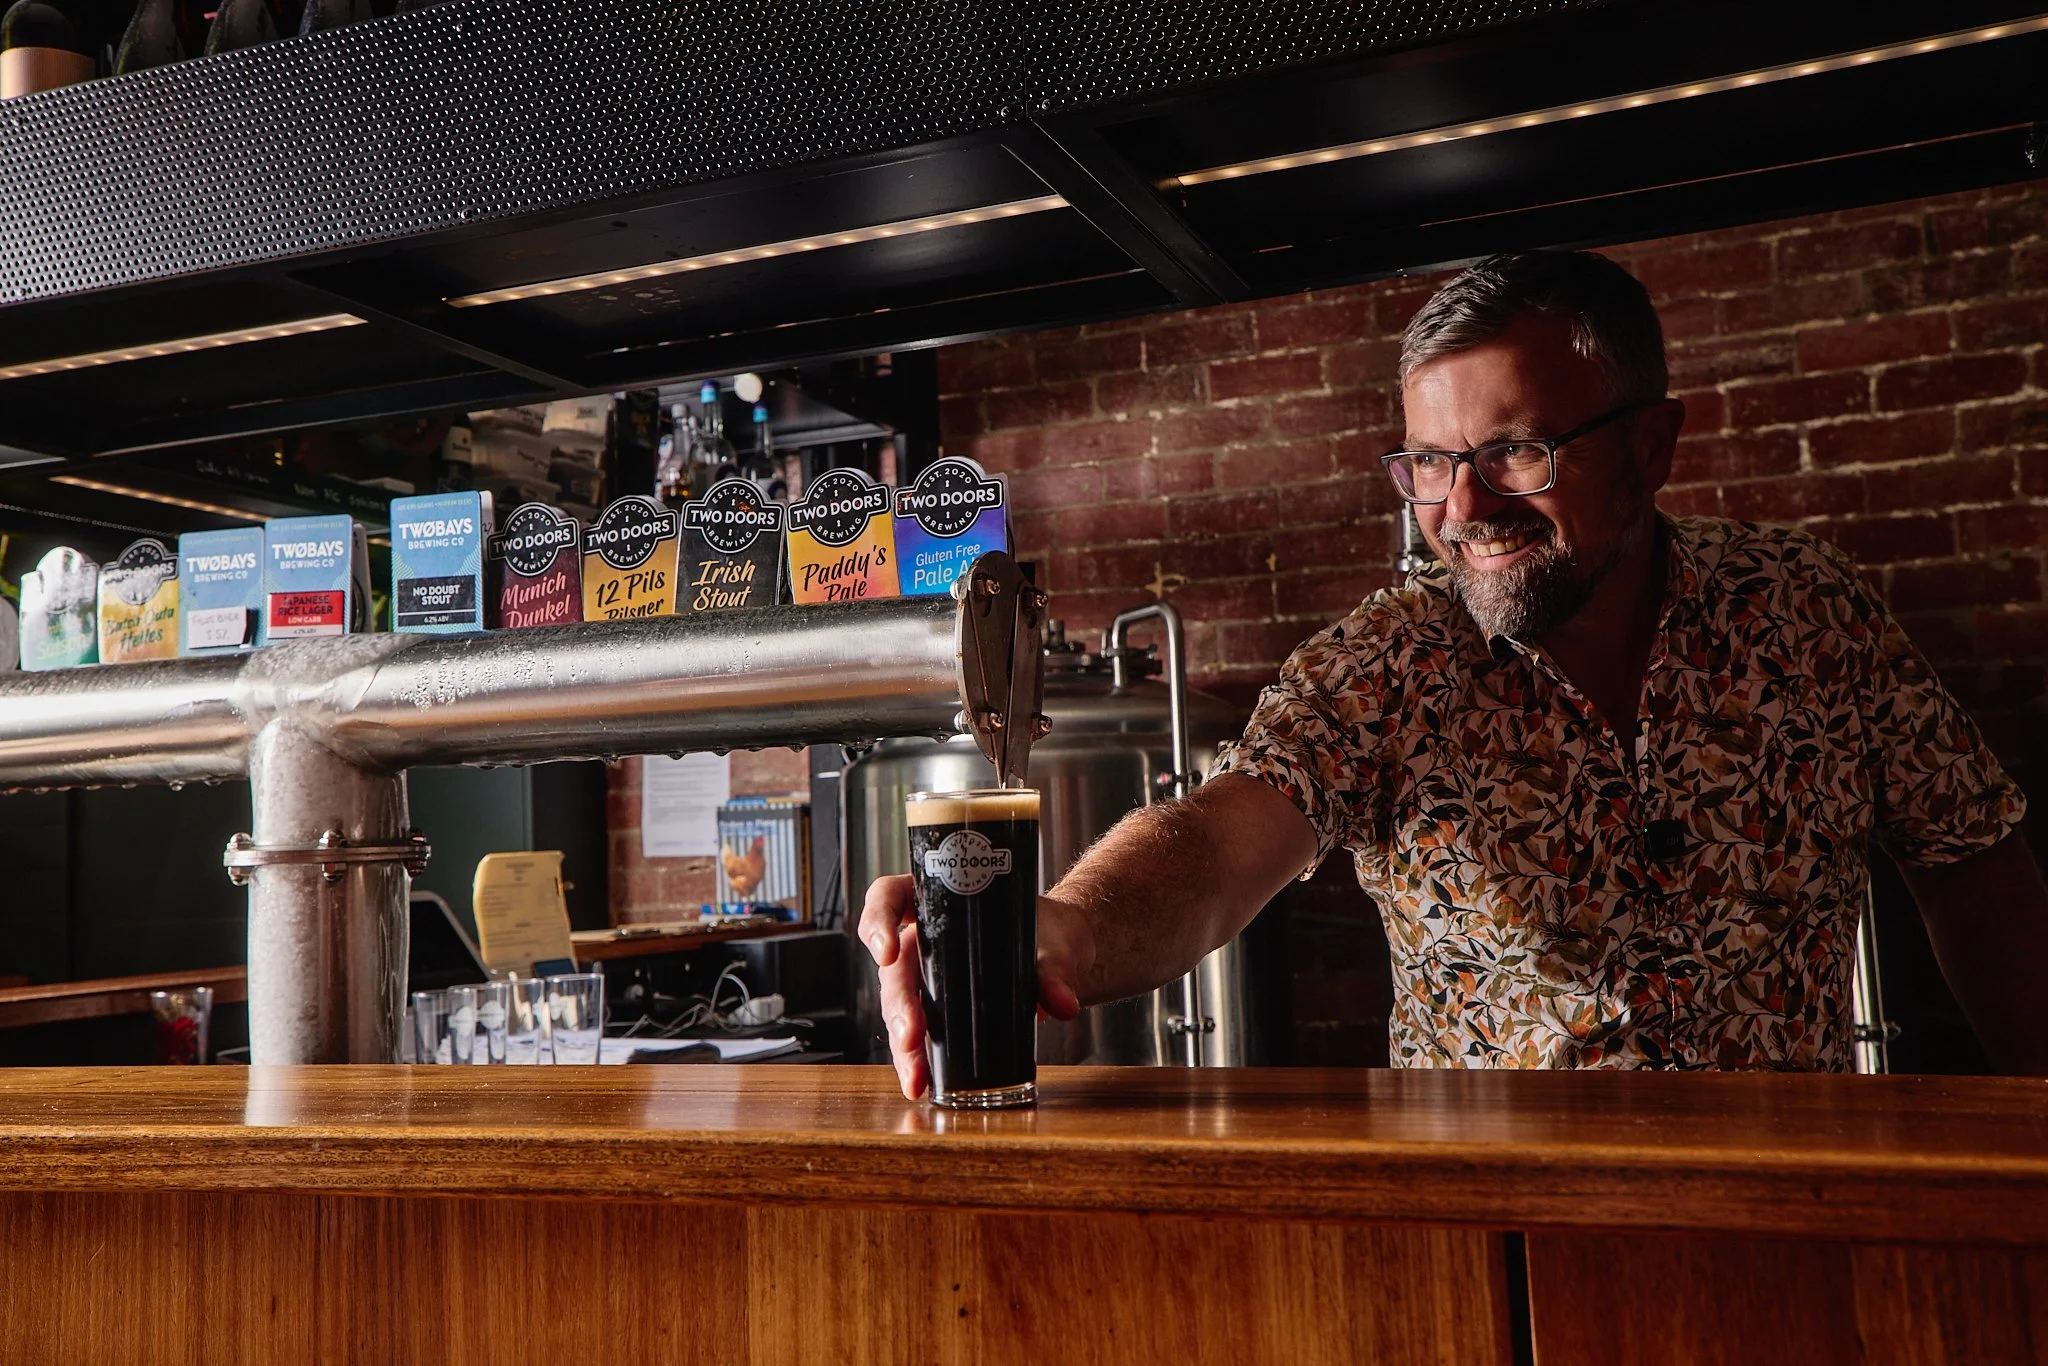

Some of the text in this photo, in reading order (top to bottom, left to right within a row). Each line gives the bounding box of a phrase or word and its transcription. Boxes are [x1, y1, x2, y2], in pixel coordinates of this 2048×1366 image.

[812, 477, 859, 499] EST. 2020
[924, 467, 972, 488] EST. 2020
[711, 487, 757, 506] EST. 2020
[901, 487, 996, 511] TWO DOORS
[605, 504, 649, 525] EST. 2020
[690, 509, 775, 526] TWO DOORS
[793, 493, 883, 523] TWO DOORS
[511, 511, 551, 532] EST. 2020
[816, 517, 862, 540] BREWING
[924, 510, 973, 531] BREWING
[407, 537, 449, 550] BREWING
[493, 528, 571, 553] TWO DOORS
[587, 519, 671, 548] TWO DOORS
[709, 530, 752, 548] BREWING
[511, 550, 553, 571] BREWING
[606, 542, 651, 563] BREWING
[915, 543, 982, 568] Gluten Free
[279, 558, 321, 570] BREWING
[690, 559, 757, 588] Irish
[800, 544, 887, 592] Paddy's
[194, 572, 234, 583] BREWING
[914, 563, 953, 590] Pale
[412, 584, 461, 597] NO DOUBT
[500, 571, 567, 610] Munich
[595, 568, 666, 608] 12 Pils
[692, 584, 752, 611] Stout
[823, 578, 868, 601] Pale
[277, 604, 334, 616] RICE LAGER
[282, 594, 331, 606] JAPANESE
[421, 594, 451, 606] STOUT
[604, 598, 665, 619] Pilsner
[287, 615, 322, 625] LOW CARB
[438, 614, 450, 623] ABV
[505, 594, 571, 628] Dunkel
[931, 856, 1006, 869] TWO DOORS
